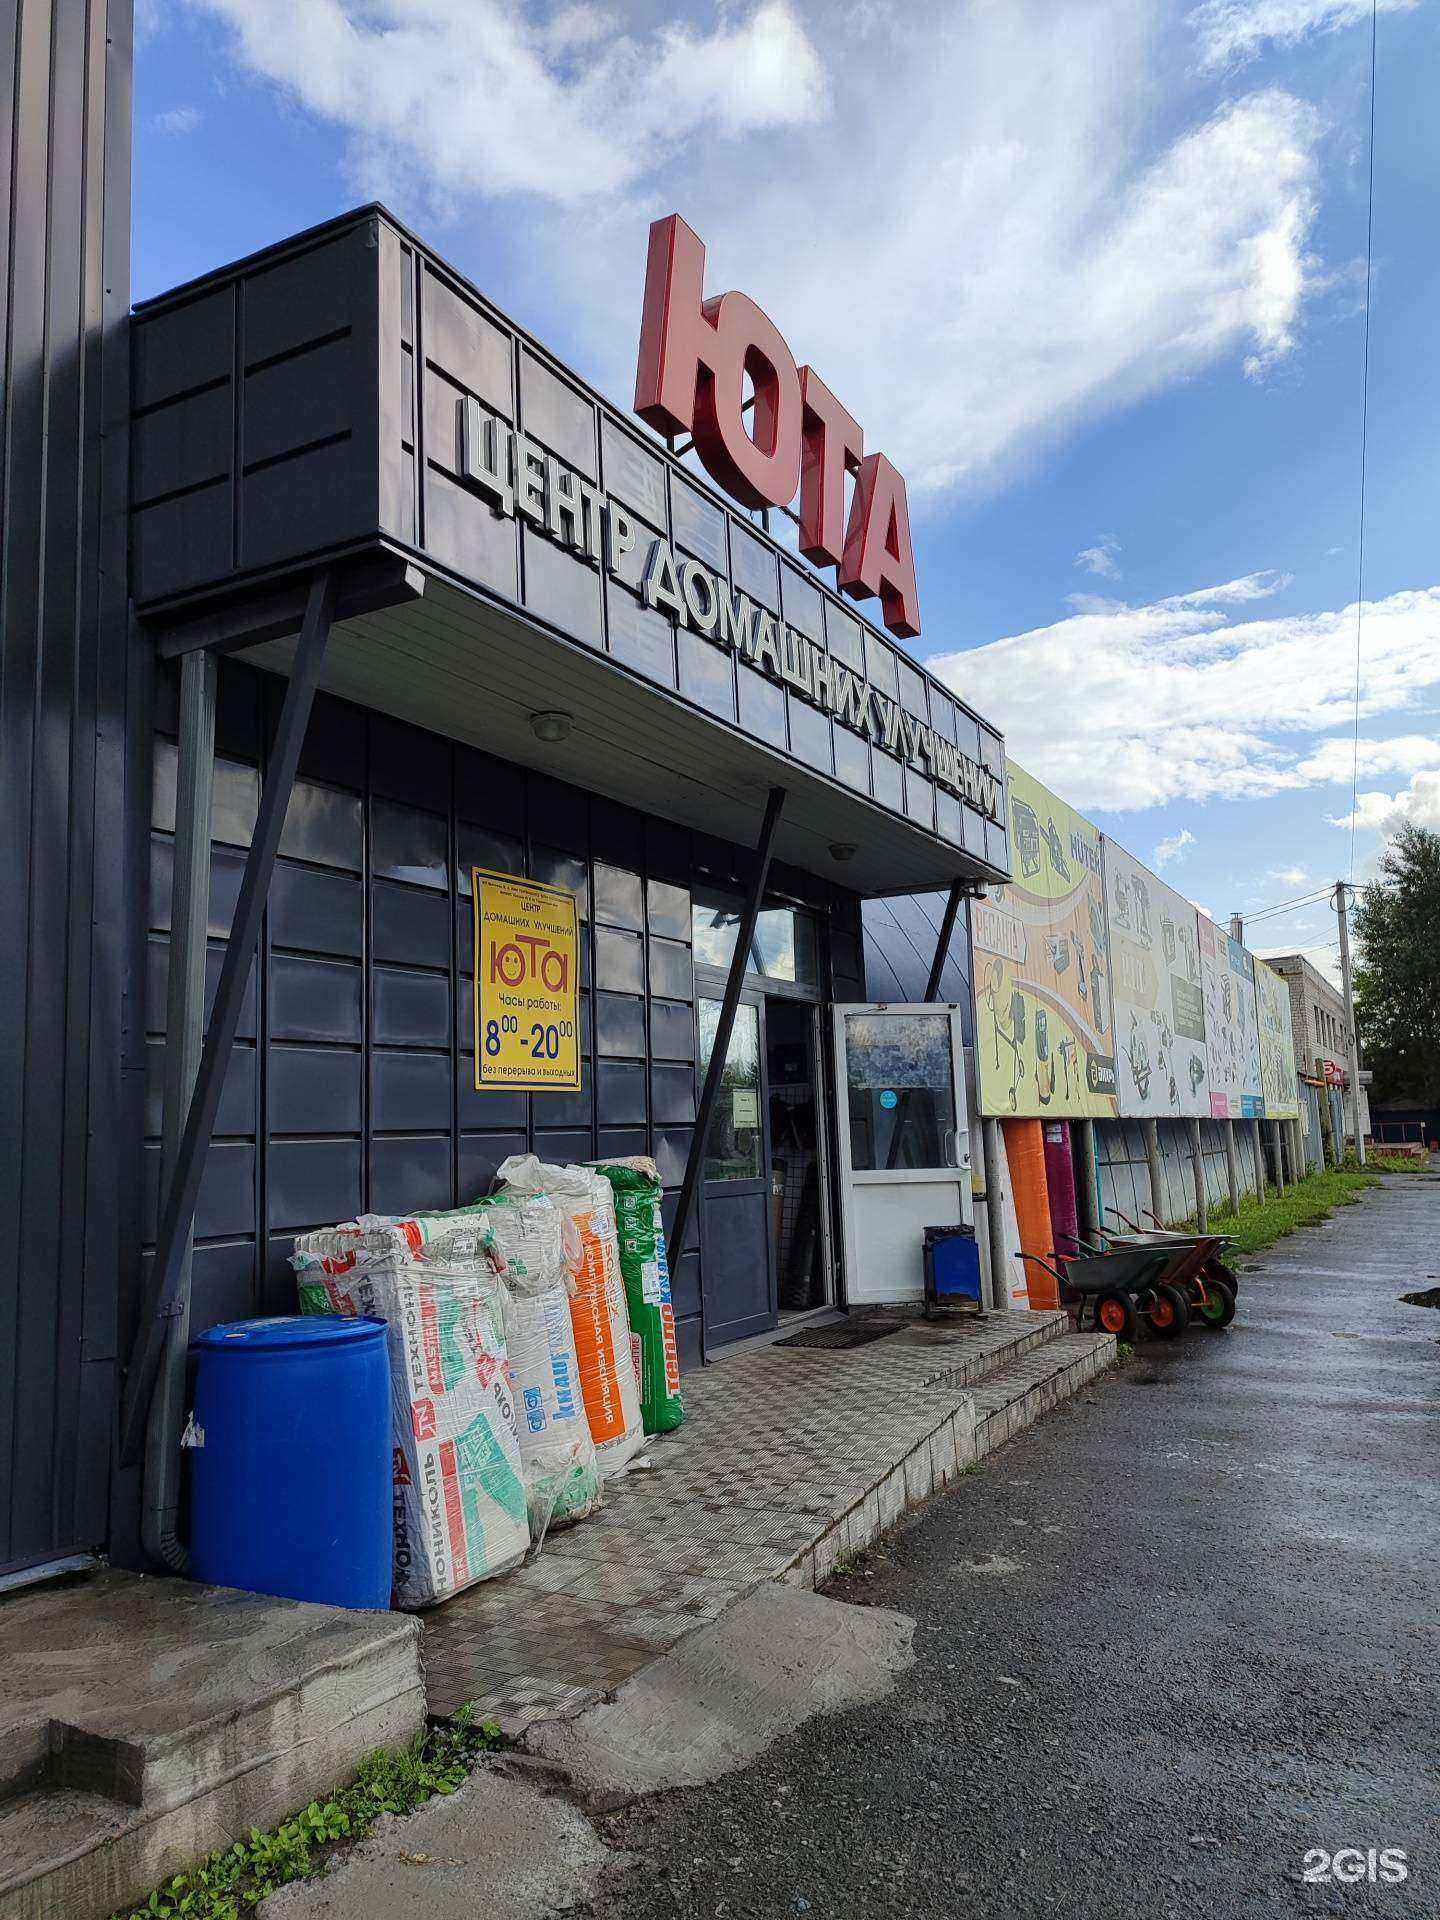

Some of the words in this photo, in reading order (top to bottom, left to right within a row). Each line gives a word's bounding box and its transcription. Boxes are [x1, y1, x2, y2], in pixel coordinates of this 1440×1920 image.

[633, 213, 921, 640] ЮТА
[455, 395, 636, 574] ЦЕНТР
[639, 536, 874, 736] ДОМАШНИХ
[872, 690, 997, 820] УЛУЧШЕНИЙ
[520, 901, 541, 913] ЦЕНТР
[483, 912, 531, 928] ДОМАШНИХ
[533, 920, 574, 937] УЛУЧШЕНИЙ
[498, 992, 525, 1007] Часы
[482, 1063, 497, 1074] без
[498, 1066, 536, 1077] перерыва
[543, 1068, 575, 1079] выходных
